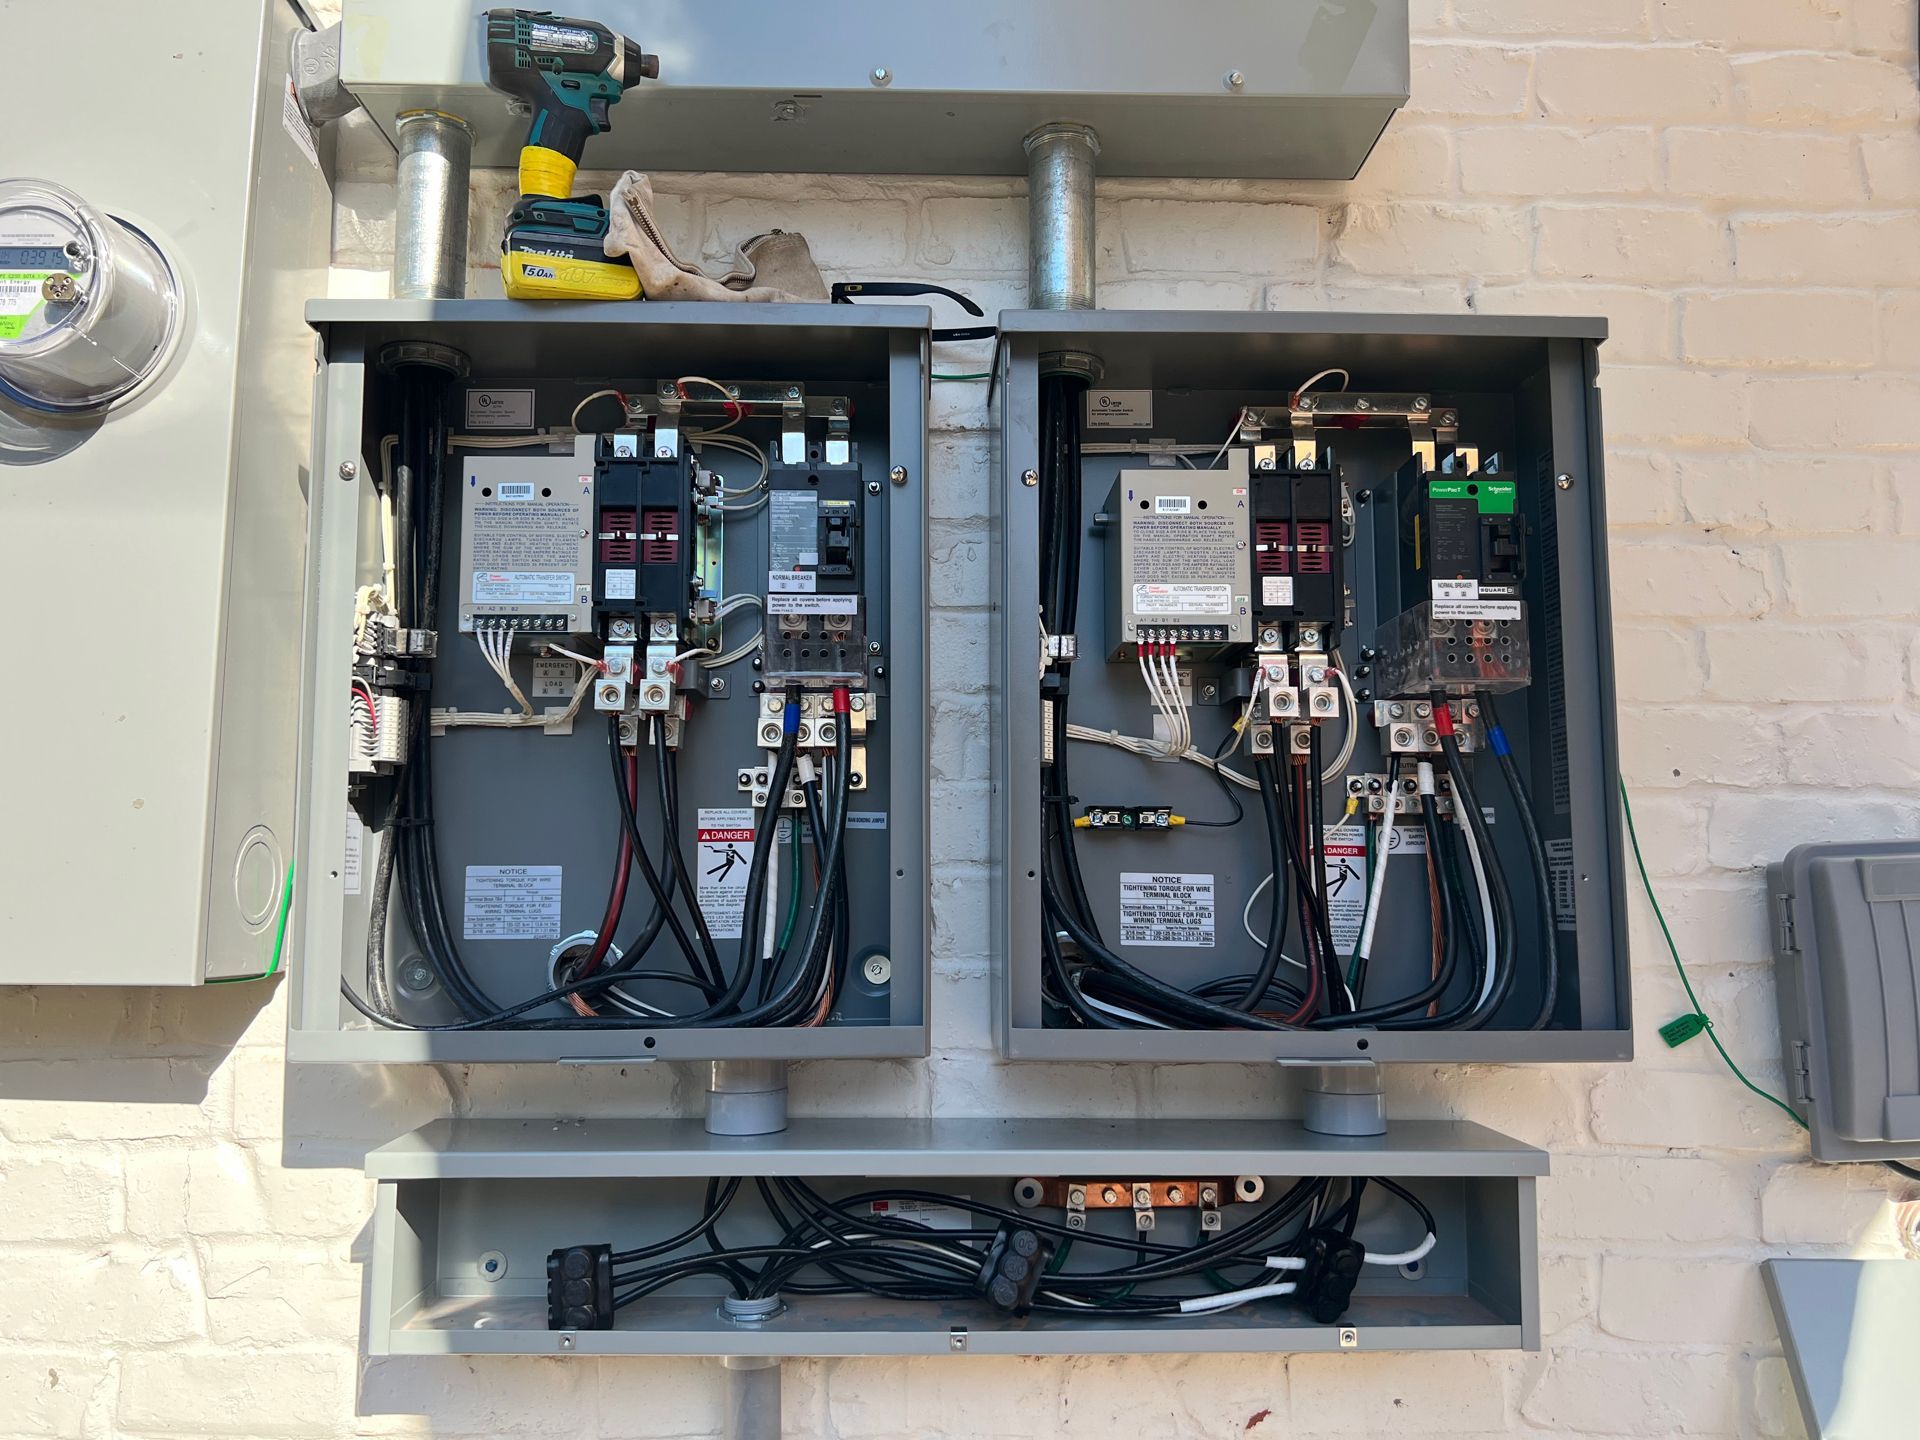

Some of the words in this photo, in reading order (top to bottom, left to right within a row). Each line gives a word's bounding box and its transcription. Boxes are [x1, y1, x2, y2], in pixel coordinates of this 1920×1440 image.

[527, 268, 554, 279] 5.0Ah
[1240, 607, 1247, 615] B
[712, 831, 750, 839] DANGER
